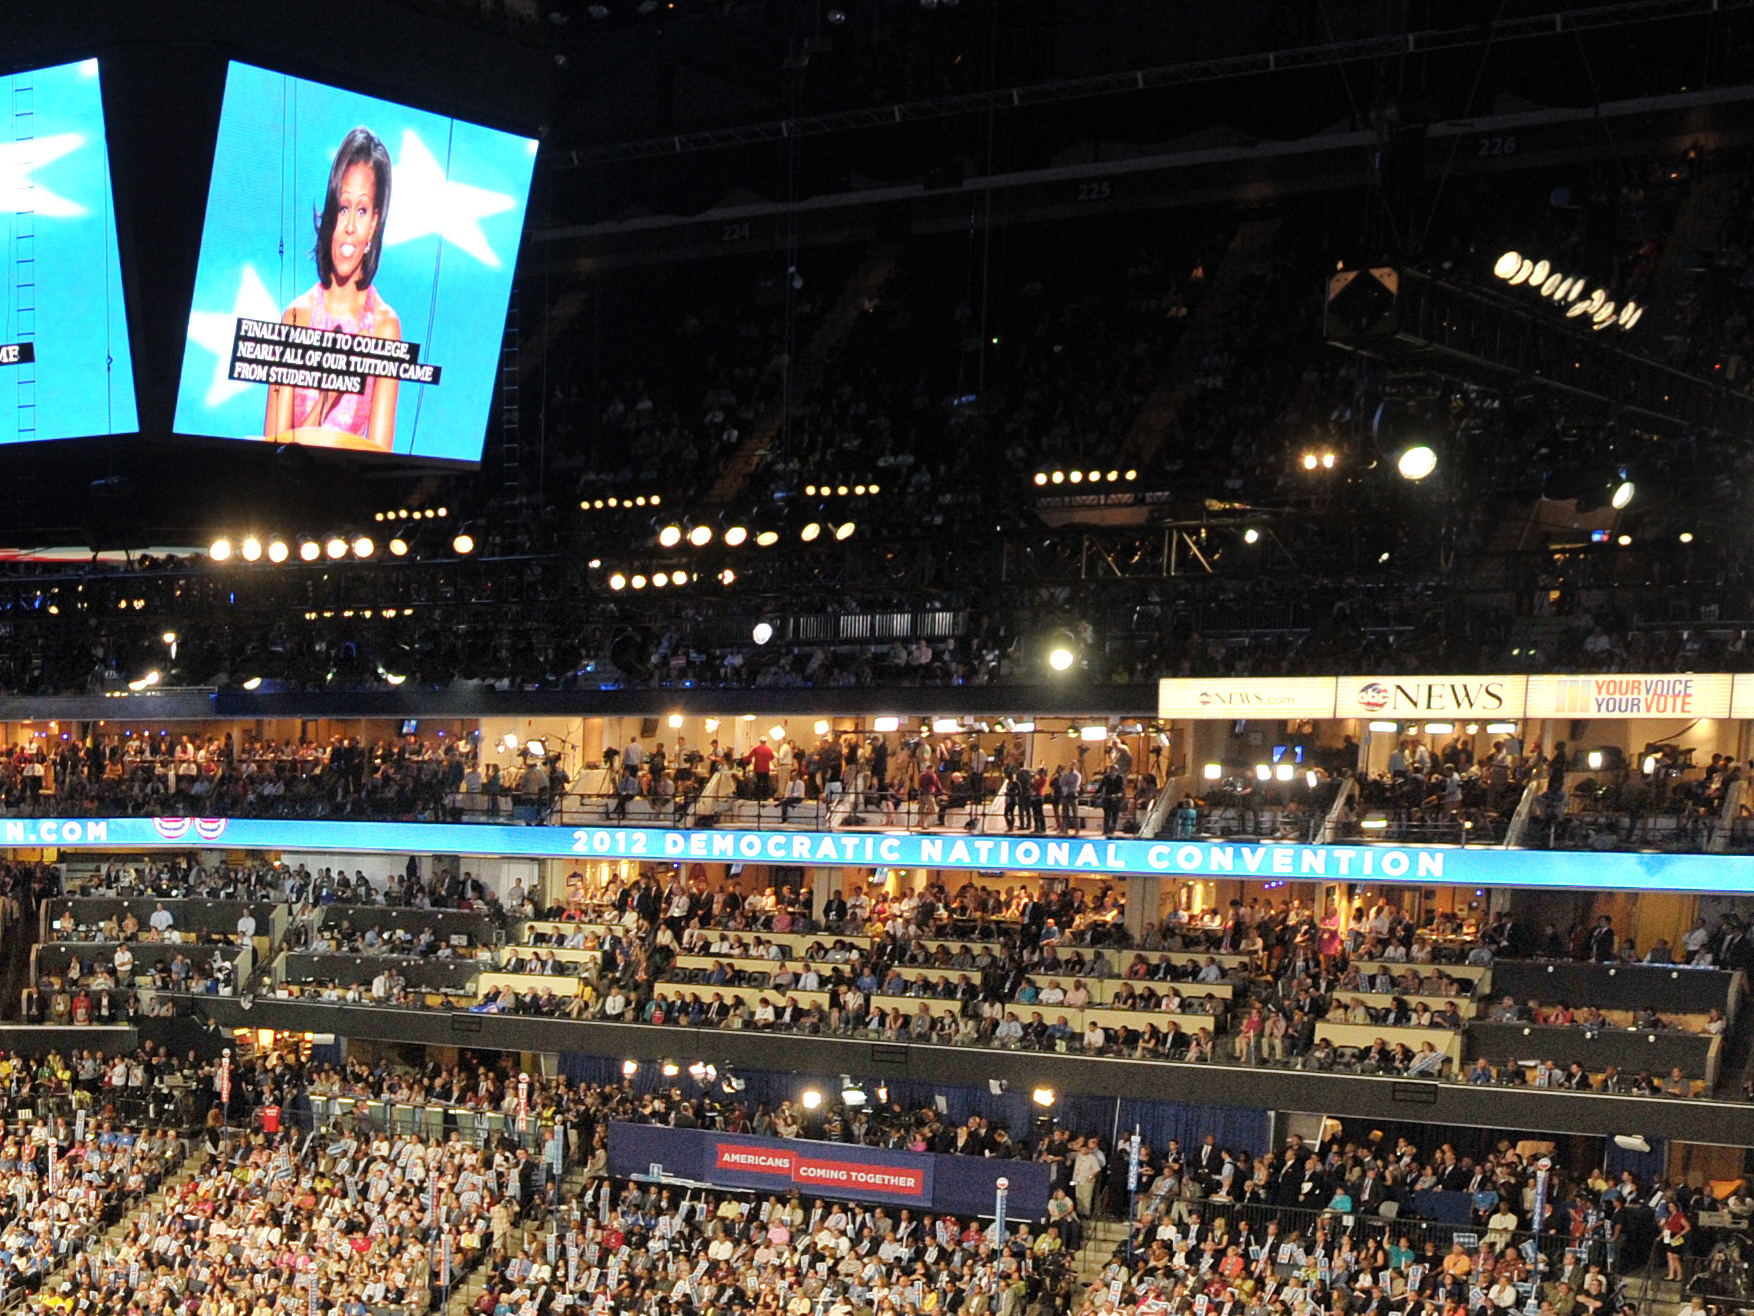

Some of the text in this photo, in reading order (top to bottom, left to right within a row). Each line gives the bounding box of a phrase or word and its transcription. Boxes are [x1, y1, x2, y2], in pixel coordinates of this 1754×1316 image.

[1478, 137, 1516, 156] 226
[1078, 182, 1112, 200] 225
[240, 320, 410, 360] FINALLY MADE IT TO COLLEGE,
[237, 341, 433, 382] NEARLY ALL OF OUR TUITION CAME
[234, 362, 361, 392] FROM STUDENT LOANS
[1392, 683, 1504, 710] NEWS
[1595, 680, 1693, 696] YOUR VOICE
[1595, 692, 1692, 713] YOUR VOTE
[573, 830, 1445, 878] 2012 DEMOCRATIC NATIONAL CONVENTION
[518, 1087, 527, 1131] UTAH
[722, 1152, 790, 1169] AMERICANS
[799, 1166, 915, 1189] COMING TOGETHER
